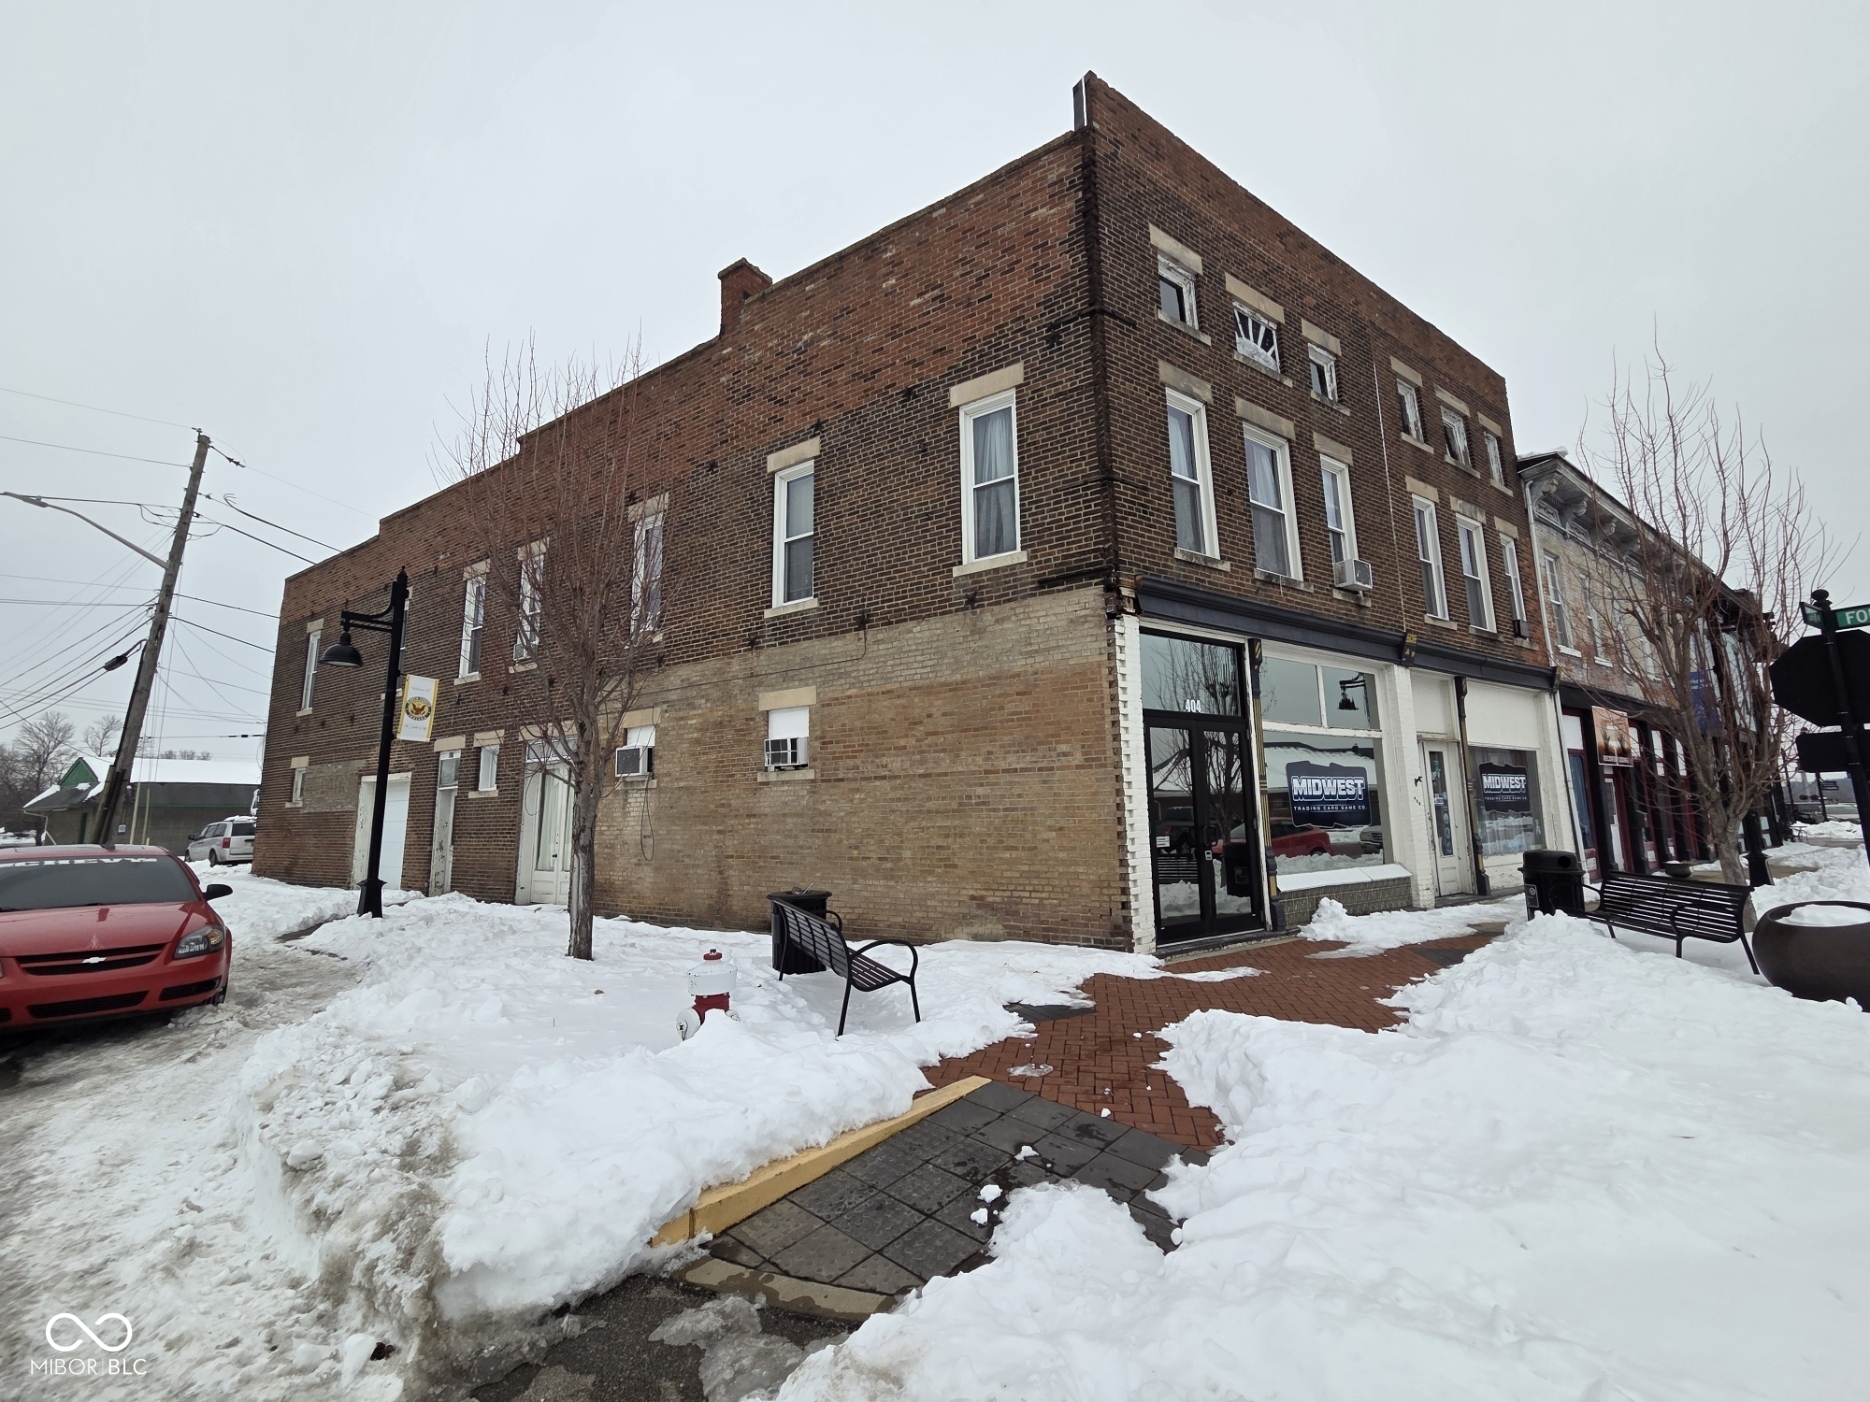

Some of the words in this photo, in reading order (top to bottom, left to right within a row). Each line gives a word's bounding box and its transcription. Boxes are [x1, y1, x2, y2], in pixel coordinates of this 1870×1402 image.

[1845, 608, 1870, 625] FO
[1185, 699, 1201, 712] 404
[1291, 776, 1365, 799] MIDWEST
[1482, 774, 1526, 792] MIDWEST
